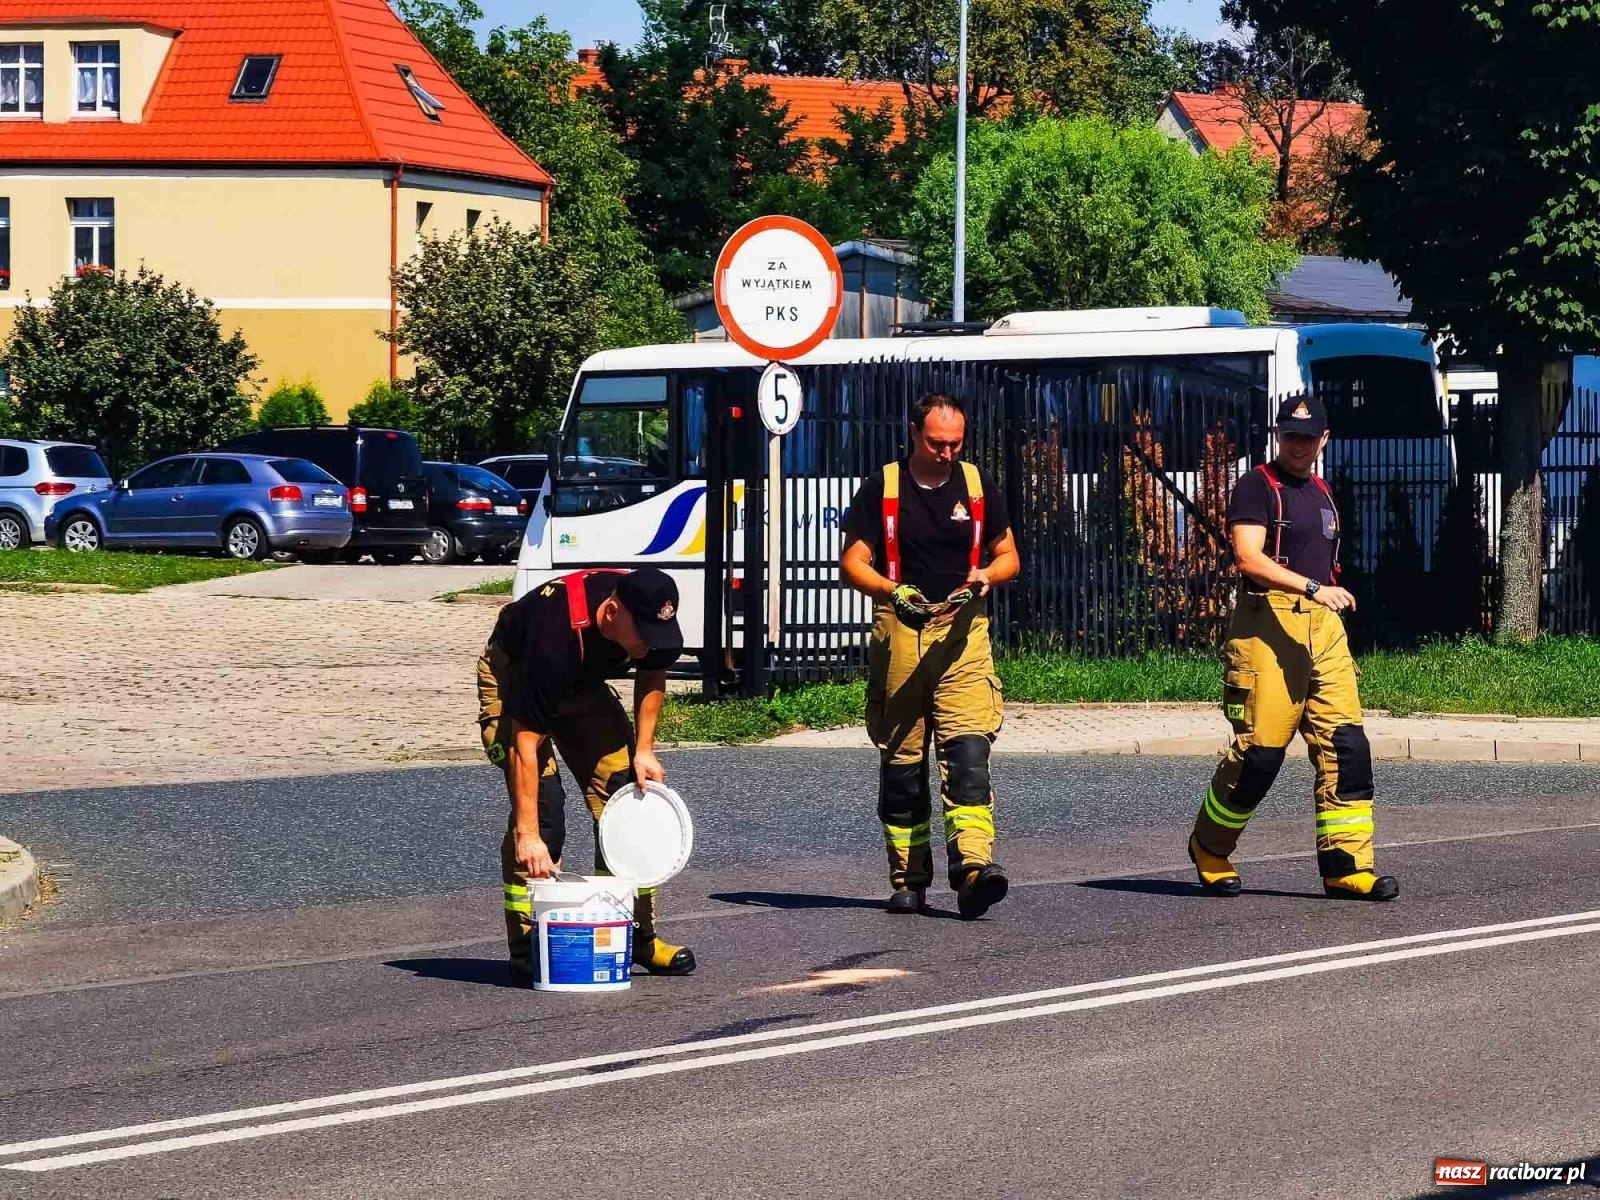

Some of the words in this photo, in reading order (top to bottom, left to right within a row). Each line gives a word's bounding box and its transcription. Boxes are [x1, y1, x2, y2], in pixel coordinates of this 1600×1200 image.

[767, 261, 787, 271] ZA
[741, 278, 812, 291] WYJĄTKIEM
[765, 306, 799, 322] PKS
[774, 373, 789, 425] 5
